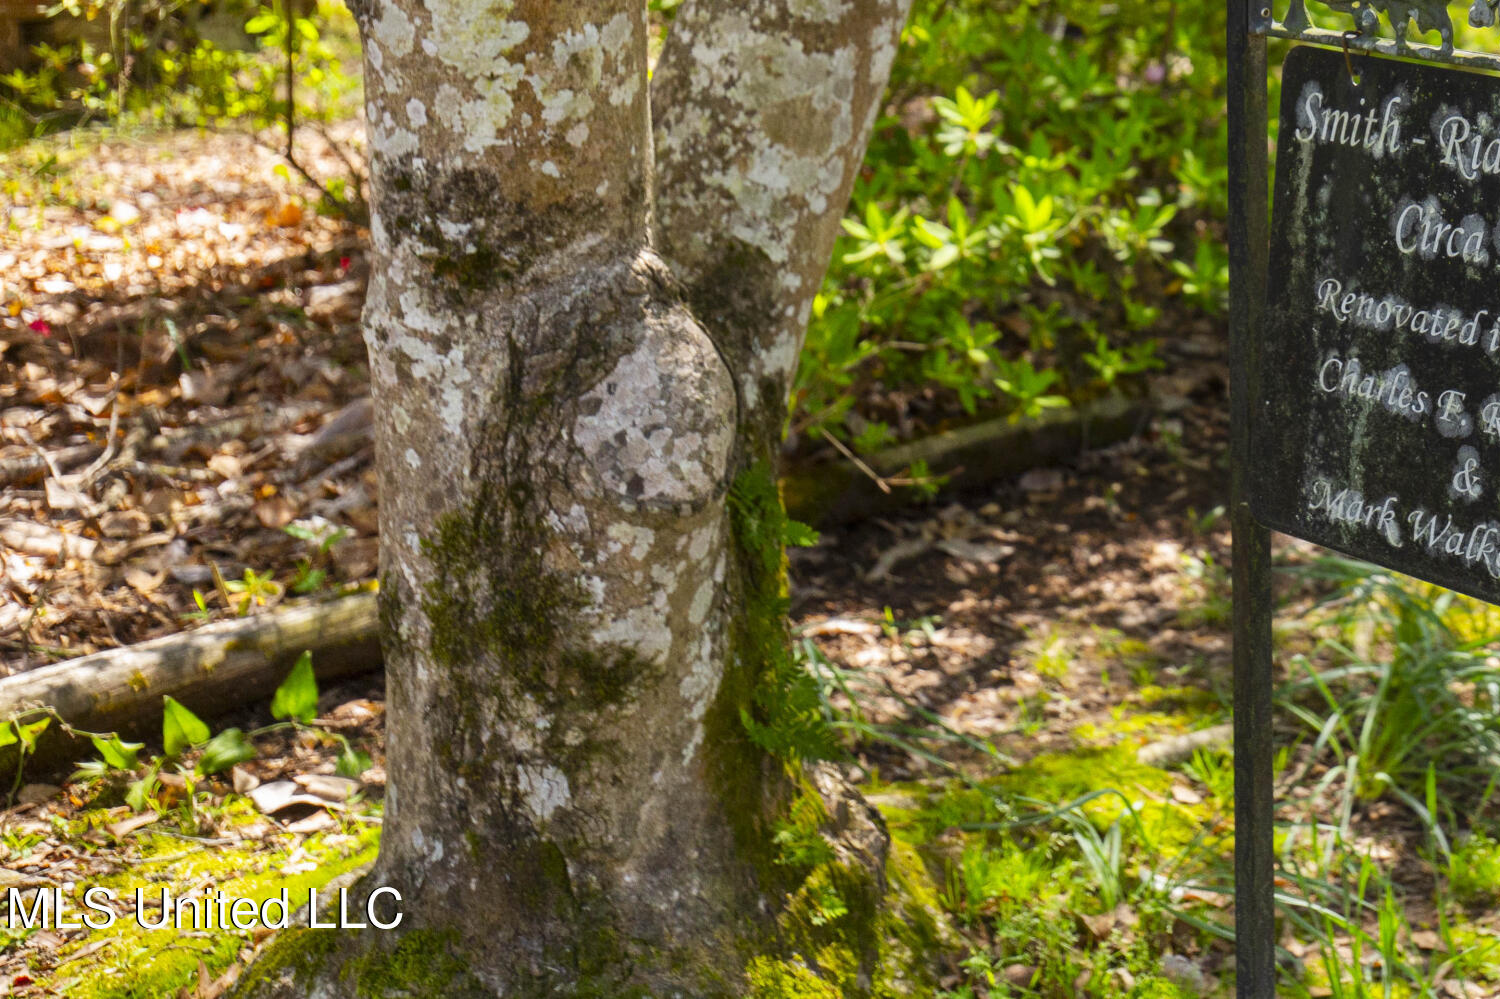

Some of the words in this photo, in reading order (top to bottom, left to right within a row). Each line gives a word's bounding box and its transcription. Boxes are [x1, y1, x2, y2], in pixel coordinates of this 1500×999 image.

[1295, 90, 1402, 154] Smith
[1395, 204, 1488, 264] Circa
[1317, 278, 1489, 347] Renovated
[1319, 358, 1429, 414] Charles
[1437, 389, 1468, 427] F.
[1452, 457, 1483, 497] &
[1308, 480, 1404, 548] Mark
